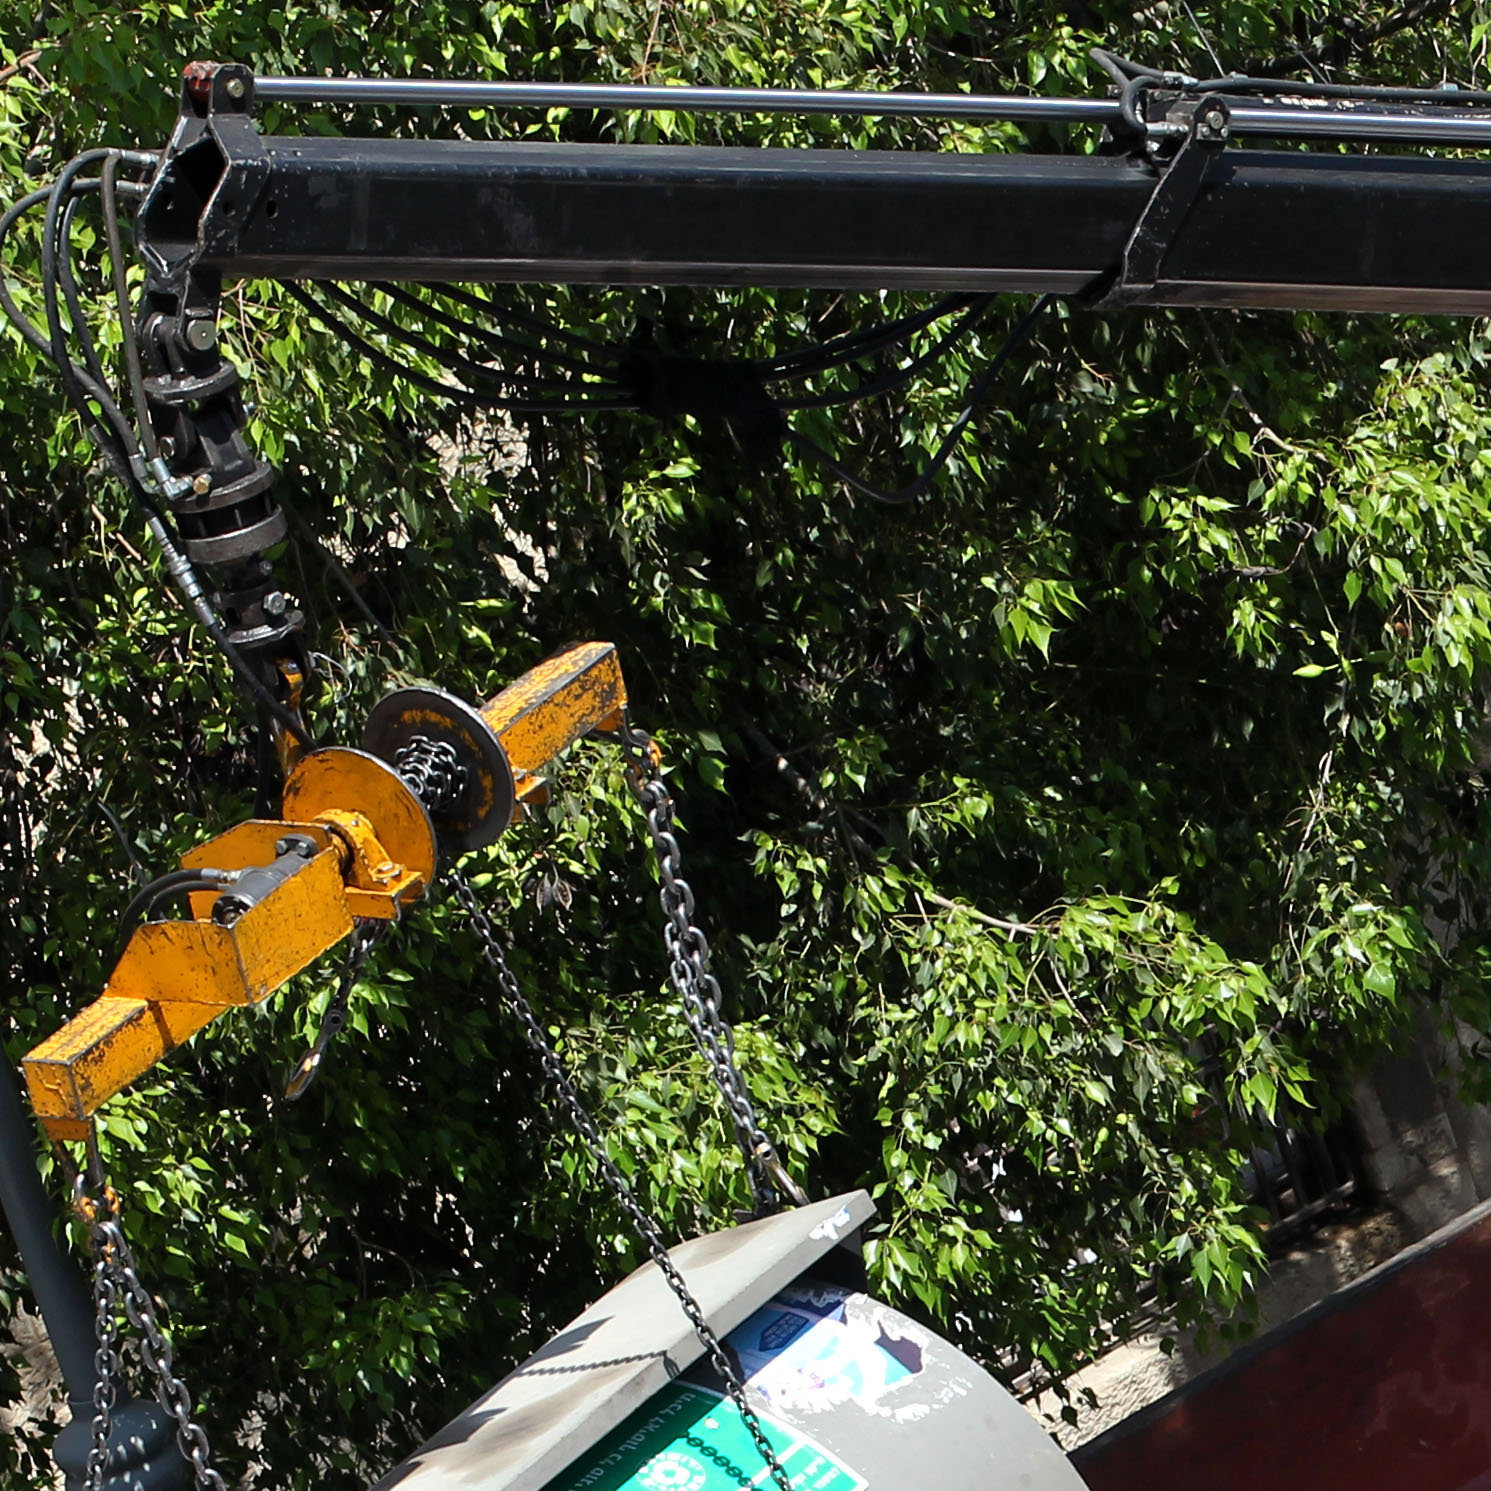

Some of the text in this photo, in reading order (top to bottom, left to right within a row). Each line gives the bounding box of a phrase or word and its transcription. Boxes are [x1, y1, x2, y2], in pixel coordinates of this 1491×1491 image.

[659, 1392, 697, 1417] מיכל
[619, 1416, 665, 1452] לאיסוף
[600, 1452, 624, 1468] כל
[575, 1468, 606, 1487] סוגי
